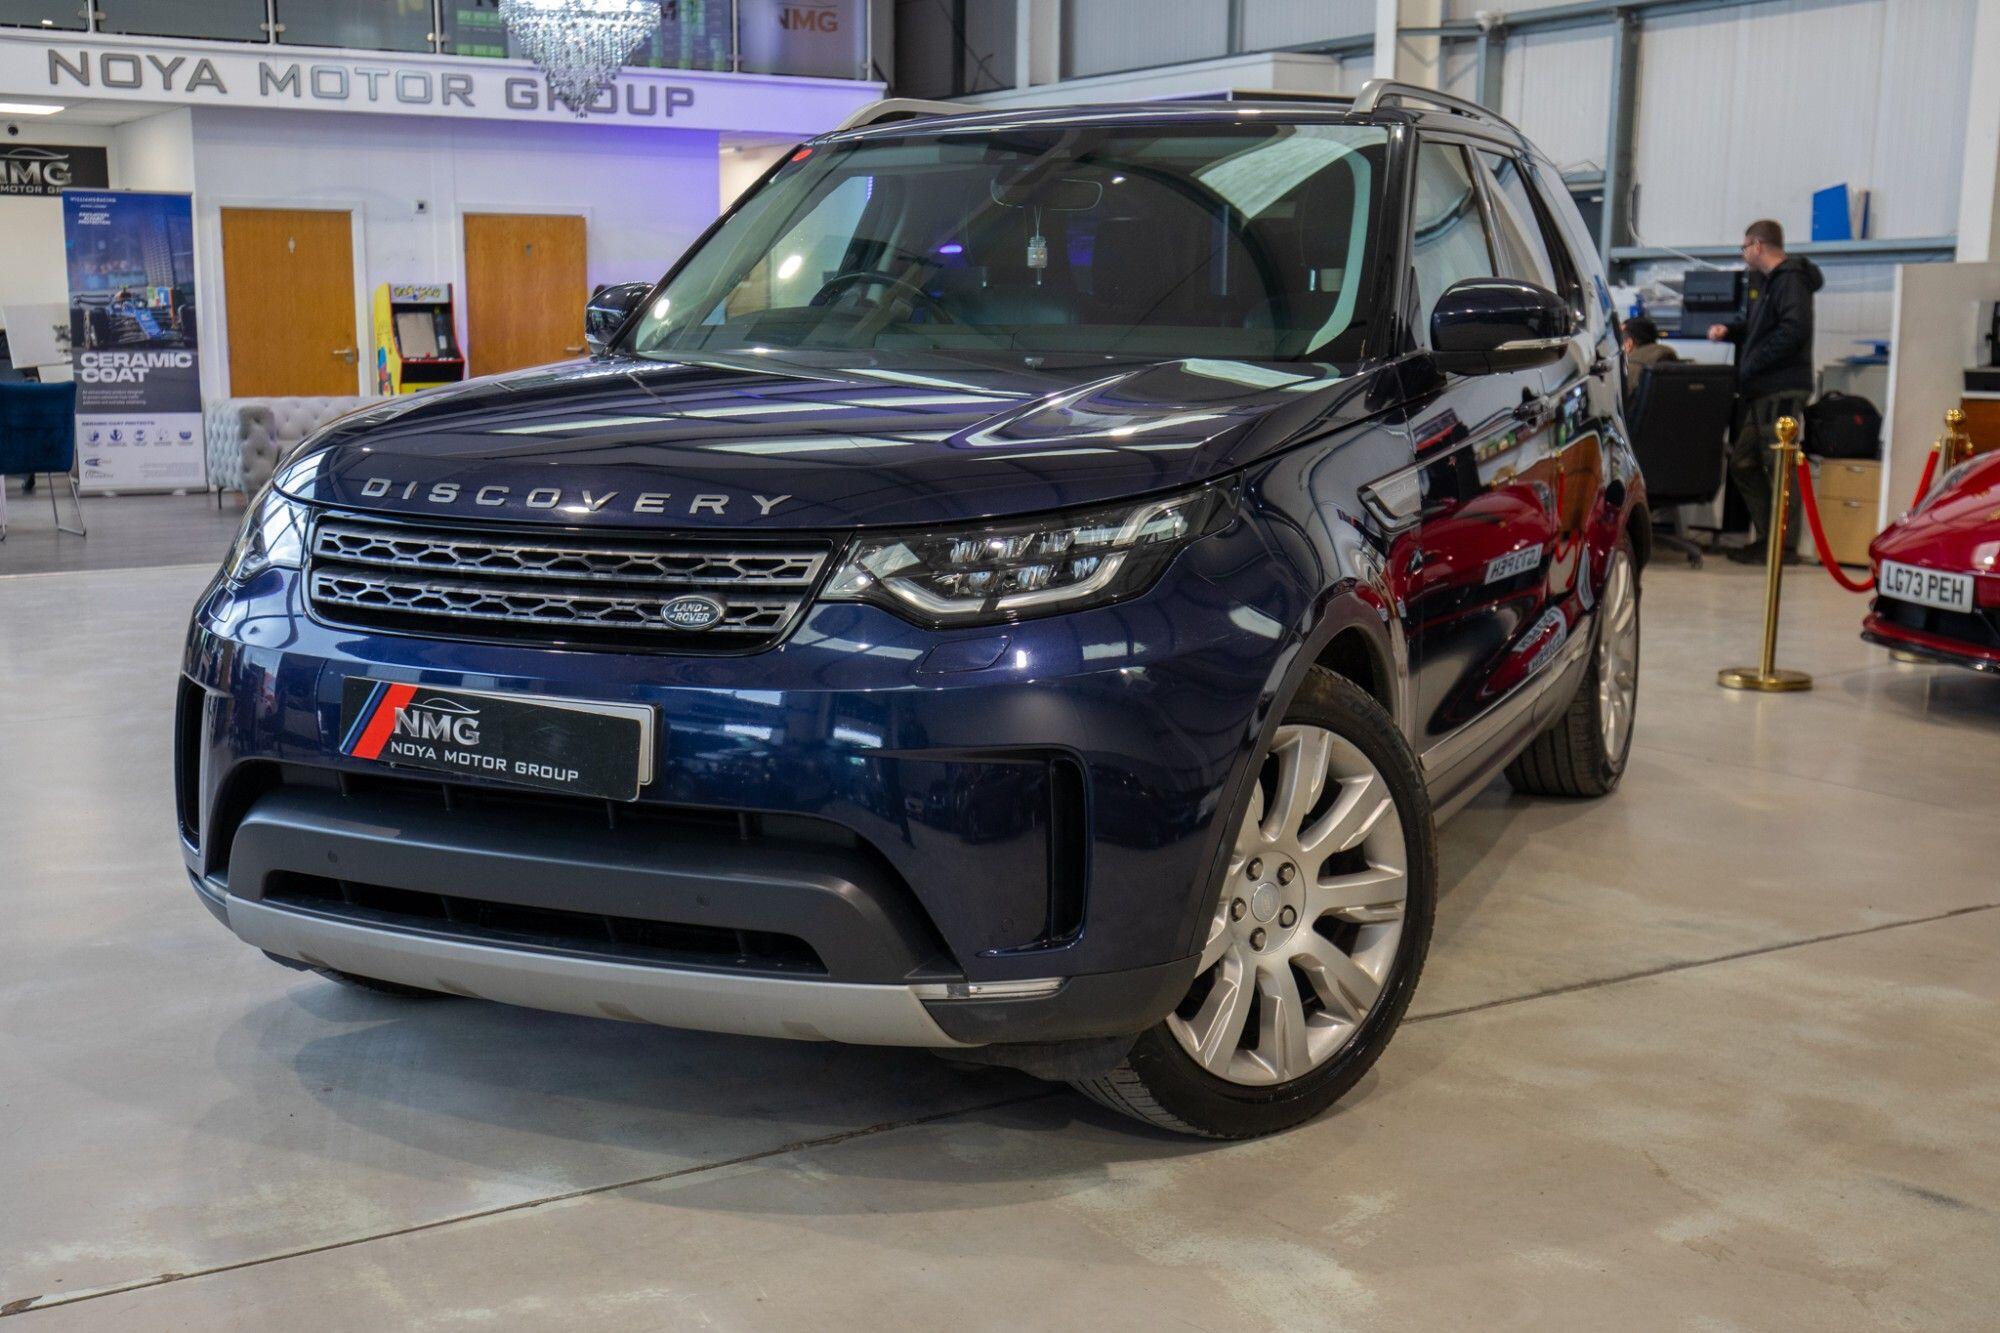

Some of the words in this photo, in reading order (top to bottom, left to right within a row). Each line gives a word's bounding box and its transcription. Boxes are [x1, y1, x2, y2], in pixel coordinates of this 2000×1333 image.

[47, 48, 228, 94] NOYA
[259, 61, 475, 107] MOTOR
[80, 352, 192, 368] CERAMIC
[81, 367, 149, 383] COAT
[361, 477, 792, 515] DISCOVERY
[1886, 566, 1924, 596] LG73
[1928, 575, 1964, 605] PEH
[393, 707, 480, 745] NMG
[391, 742, 437, 760] NOYA
[444, 751, 507, 772] MOTOR
[515, 762, 579, 782] GROUP
